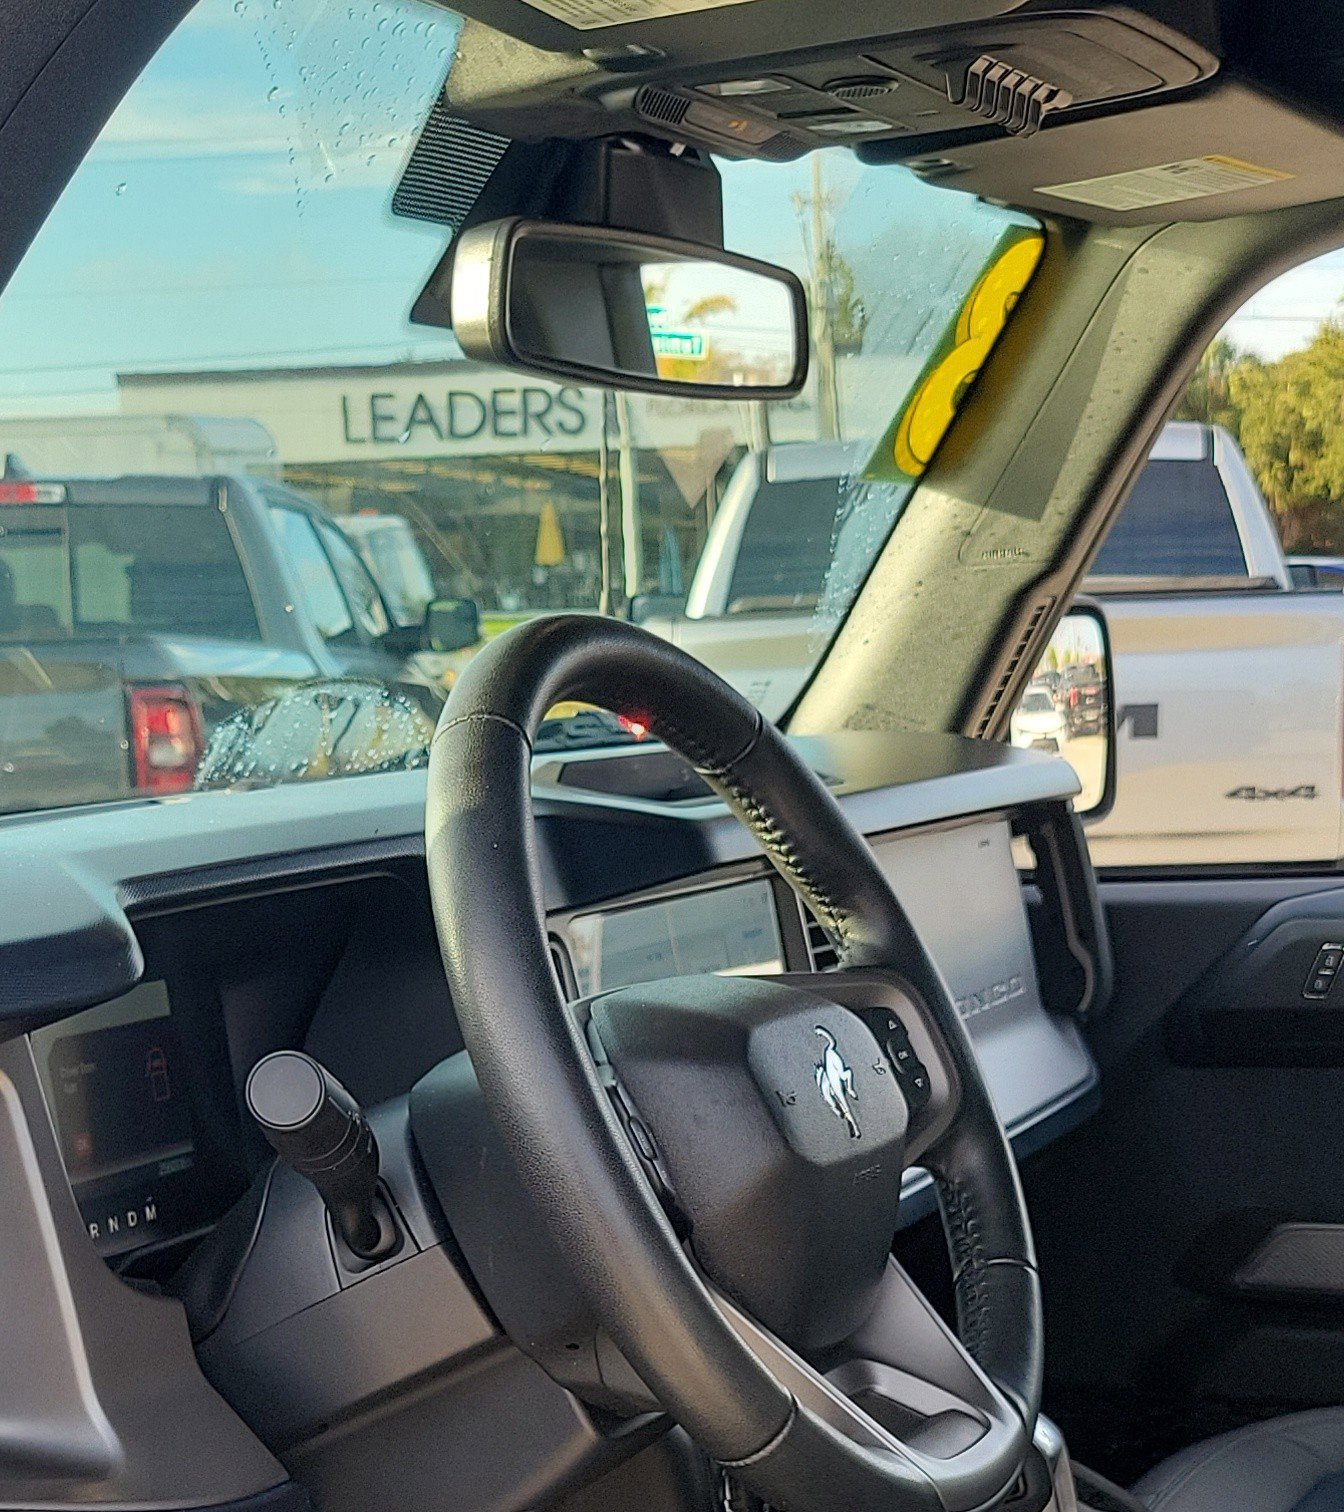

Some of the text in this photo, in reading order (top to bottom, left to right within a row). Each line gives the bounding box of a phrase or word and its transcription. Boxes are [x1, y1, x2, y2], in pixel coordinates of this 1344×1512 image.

[342, 386, 586, 443] LEADERS
[89, 1223, 101, 1239] R
[107, 1216, 120, 1234] N
[127, 1211, 139, 1228] D
